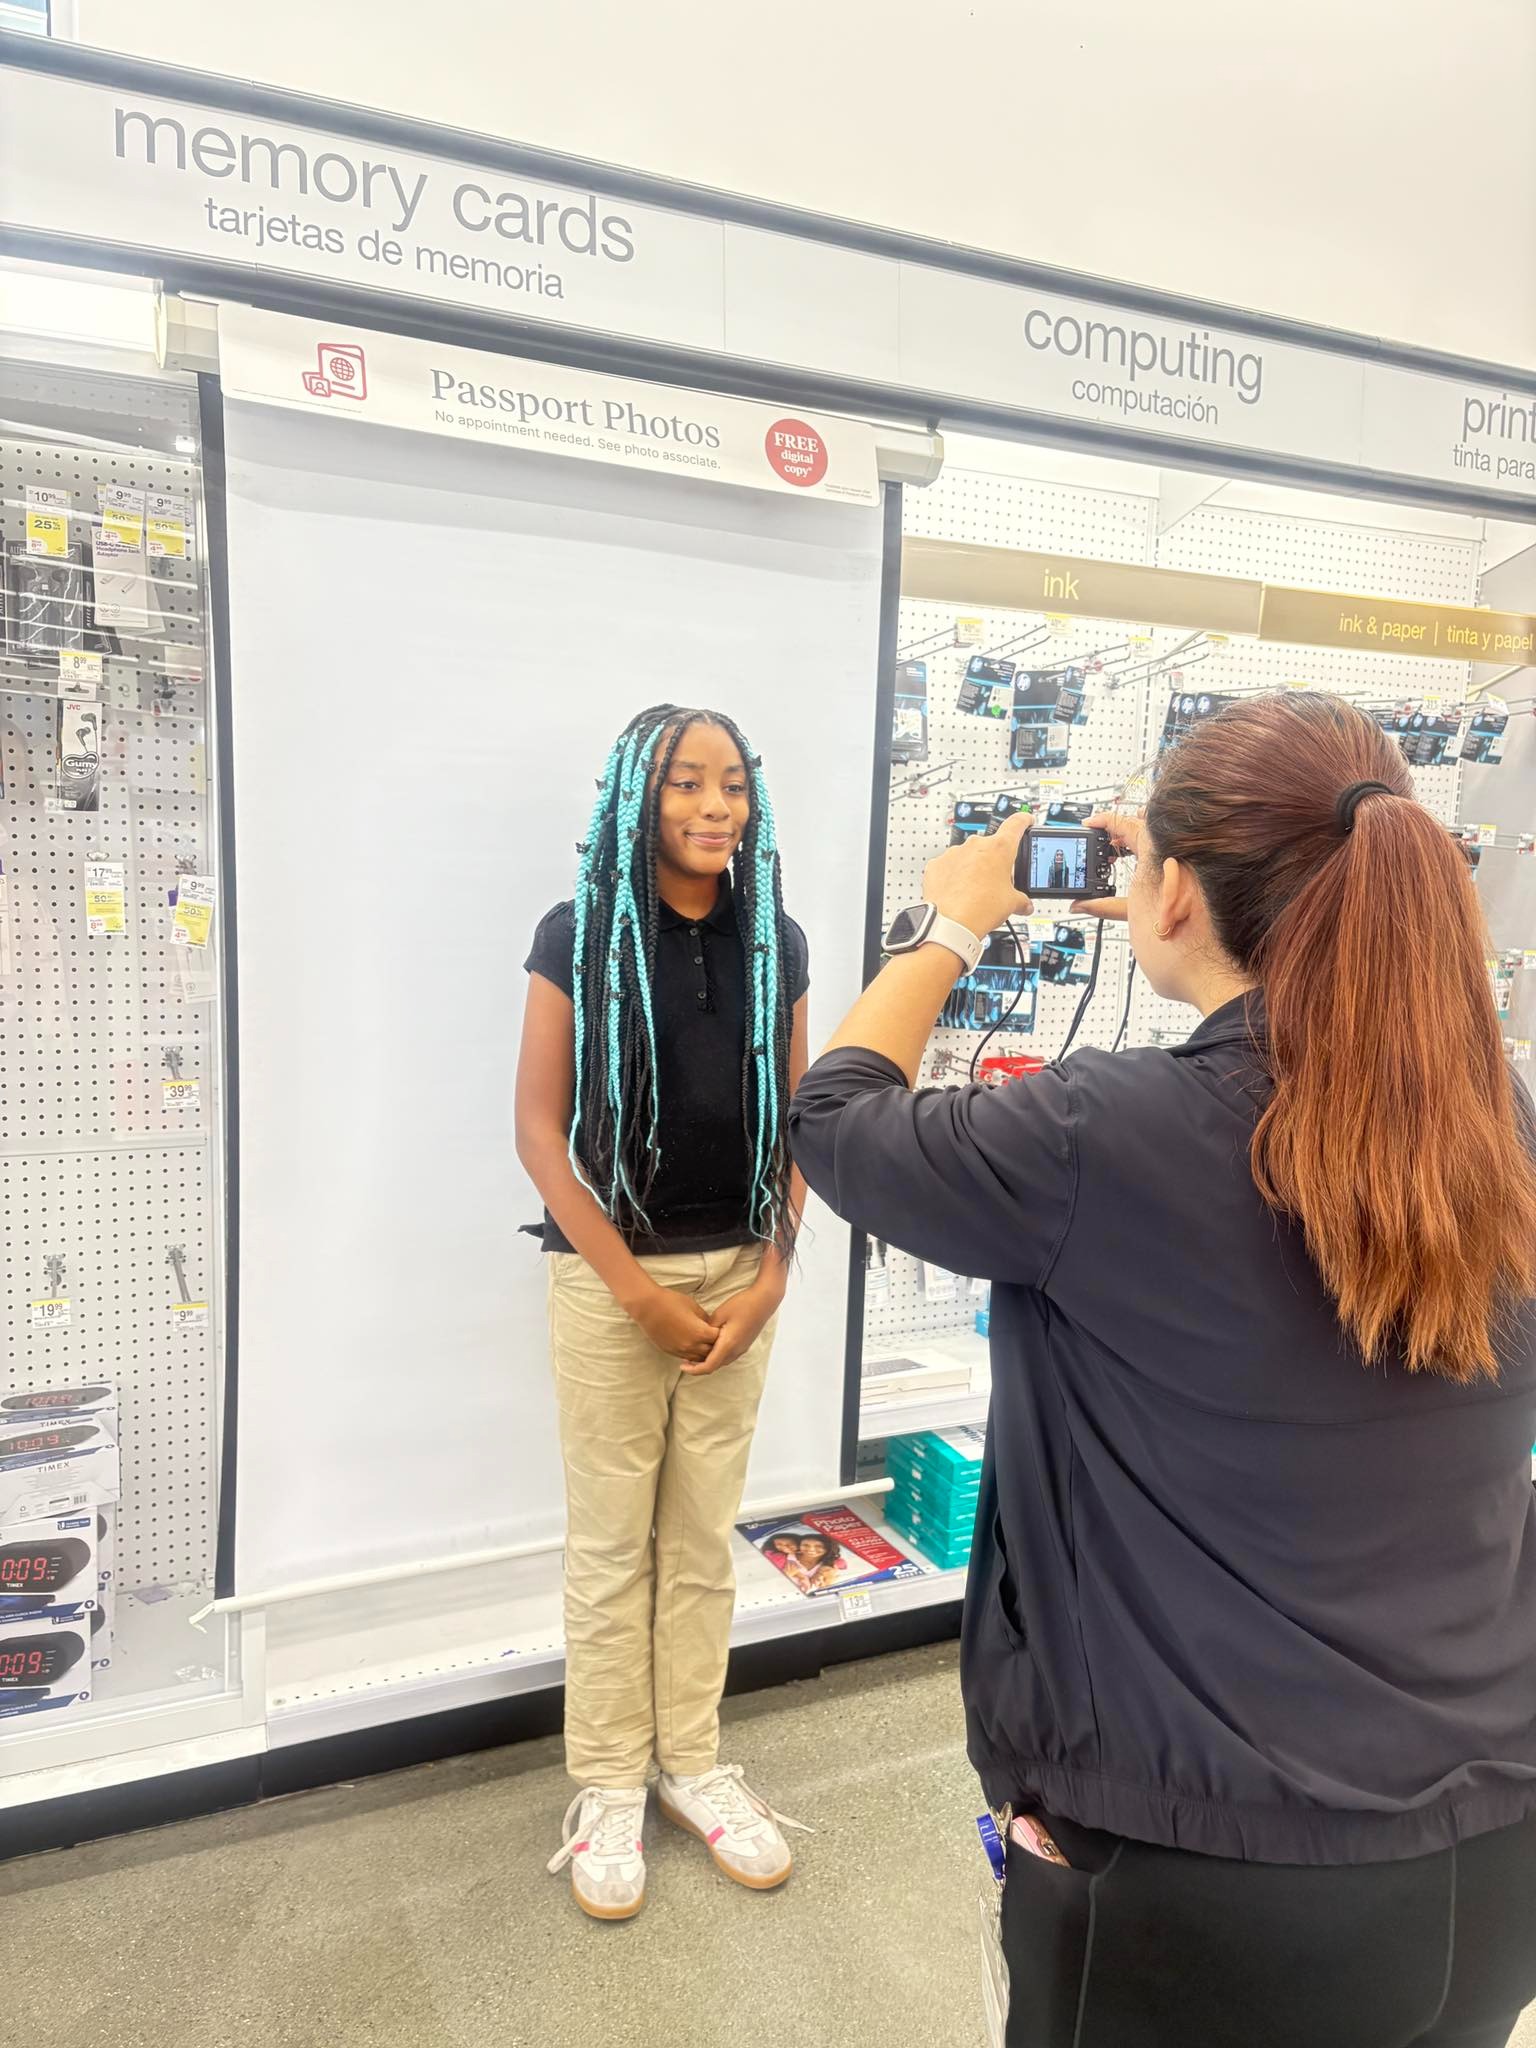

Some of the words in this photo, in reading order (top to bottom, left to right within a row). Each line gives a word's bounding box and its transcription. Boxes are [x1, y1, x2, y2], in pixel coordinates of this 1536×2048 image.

[115, 107, 427, 232] memory
[453, 182, 635, 263] cards
[204, 197, 345, 255] tarjetas
[357, 229, 403, 267] de
[416, 241, 564, 299] memoria
[1024, 309, 1263, 404] computing
[430, 369, 594, 427] Passport
[602, 400, 721, 449] Photos
[1072, 378, 1219, 425] computación
[435, 410, 454, 425] No
[458, 415, 540, 442] appointment
[544, 427, 594, 449] needed.
[597, 438, 622, 453] See
[625, 443, 659, 461] photo
[662, 449, 721, 470] associate.
[774, 431, 819, 453] FREE
[781, 450, 814, 464] digital
[1453, 444, 1491, 472] tinta
[1497, 456, 1536, 480] para
[1043, 568, 1080, 601] ink
[1339, 613, 1362, 633] ink
[1366, 616, 1378, 635] &
[1381, 621, 1426, 642] paper
[1447, 625, 1478, 645] tinta
[1482, 633, 1491, 651] y
[1494, 634, 1533, 653] papel
[65, 760, 98, 769] Gumy
[37, 1461, 70, 1472] TIMEX
